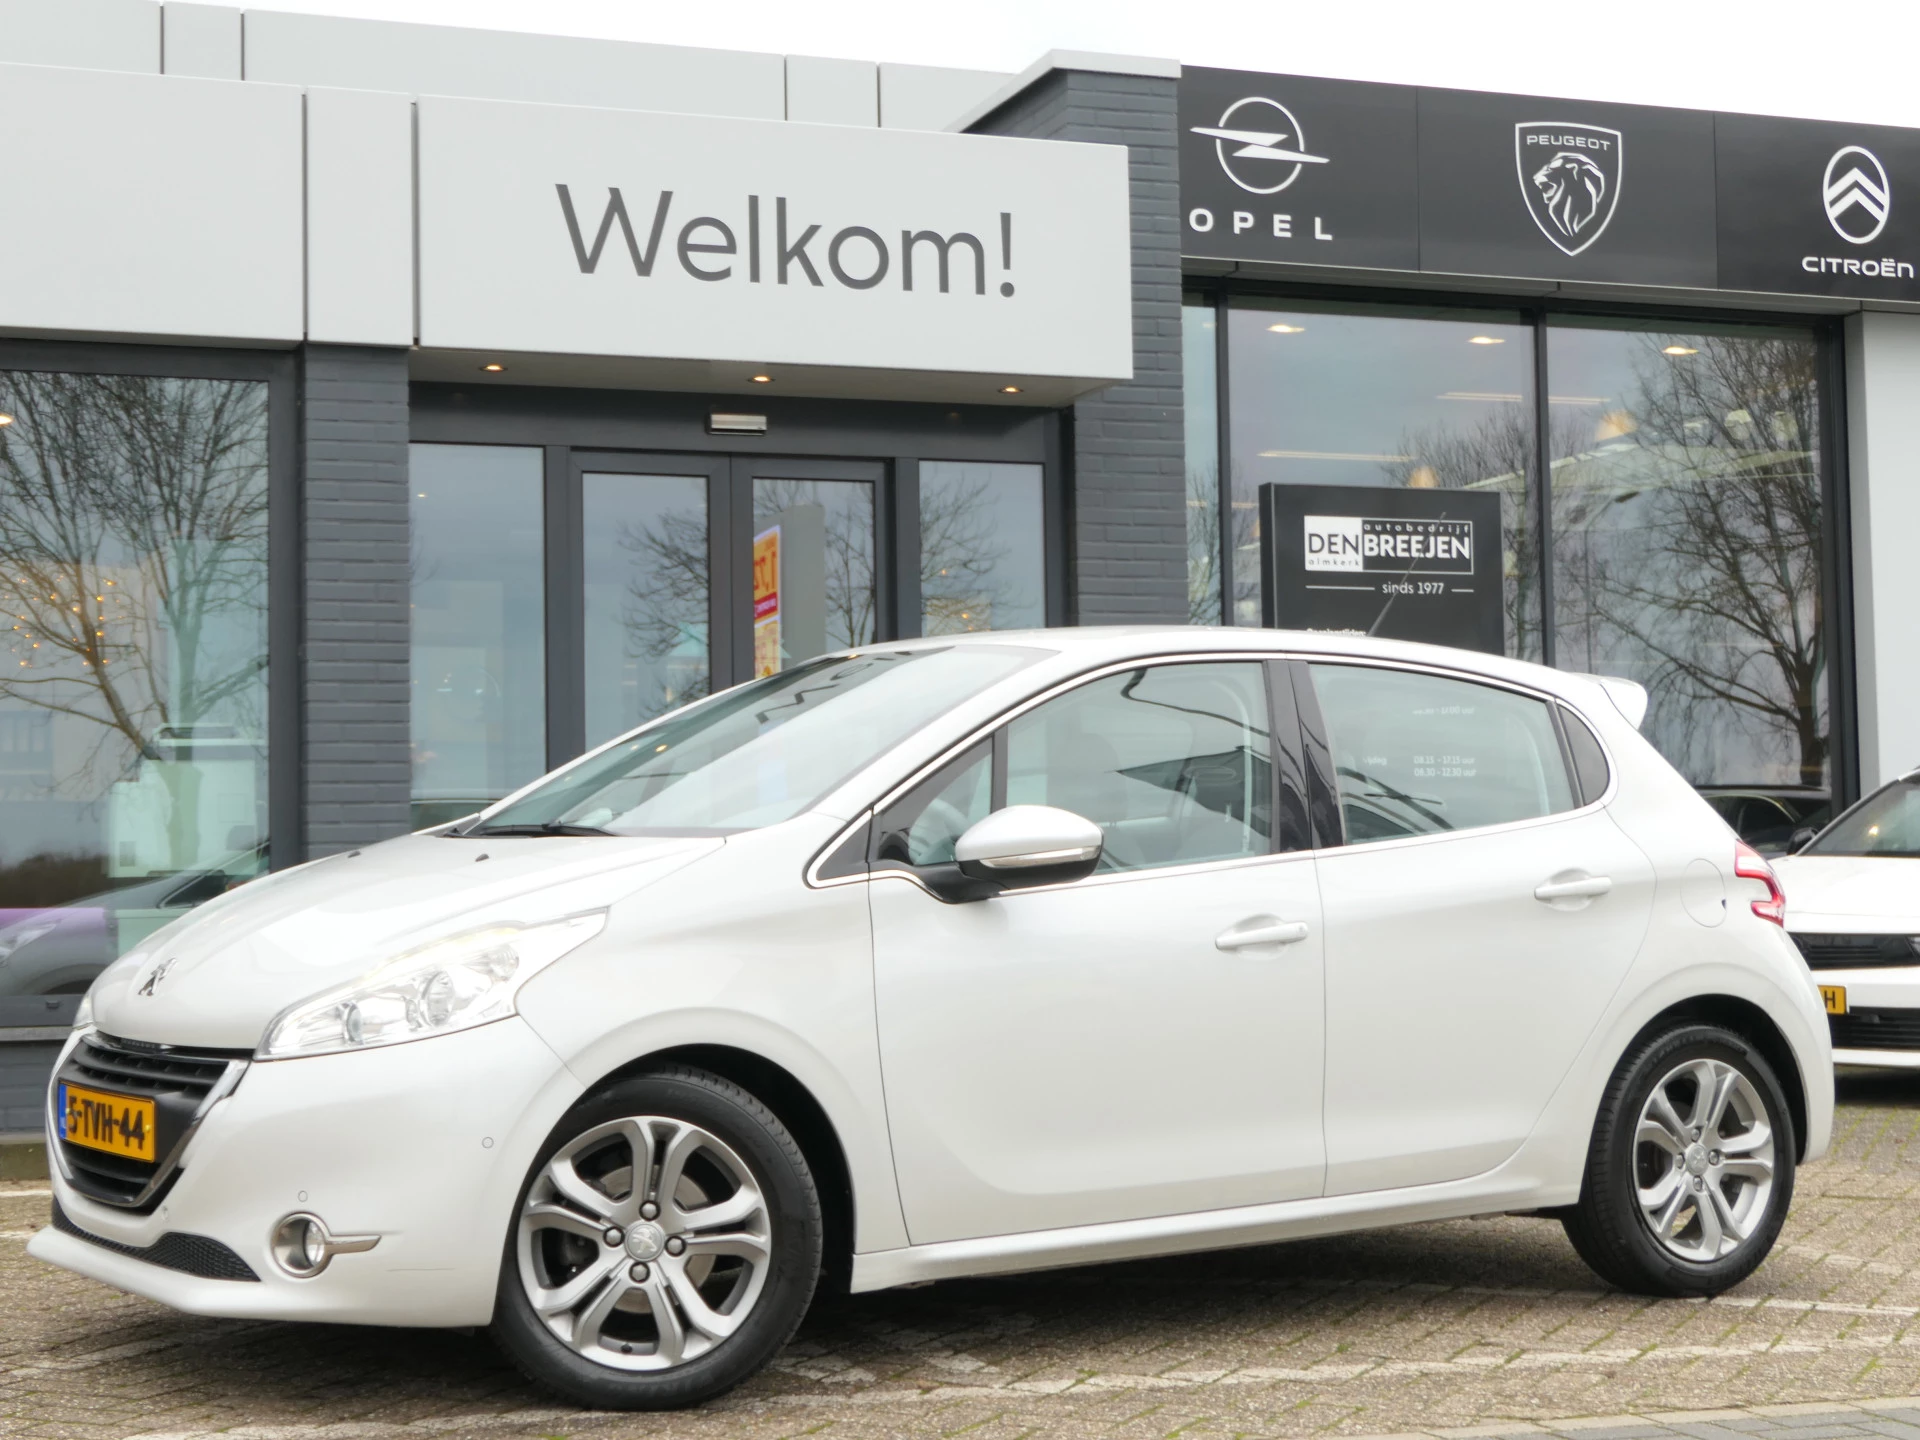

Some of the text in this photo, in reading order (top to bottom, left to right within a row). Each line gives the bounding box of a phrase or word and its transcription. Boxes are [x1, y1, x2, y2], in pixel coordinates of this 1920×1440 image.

[1526, 135, 1611, 151] PEUGEOT
[1188, 207, 1333, 241] OPEL
[554, 183, 1015, 298] Welkom!
[1363, 523, 1470, 535] autobedrijf
[1308, 533, 1471, 560] DEN BREEJEN
[1308, 557, 1360, 567] almkerk
[1382, 581, 1445, 595] sinds 1977
[68, 1095, 146, 1151] 5-TVH-44
